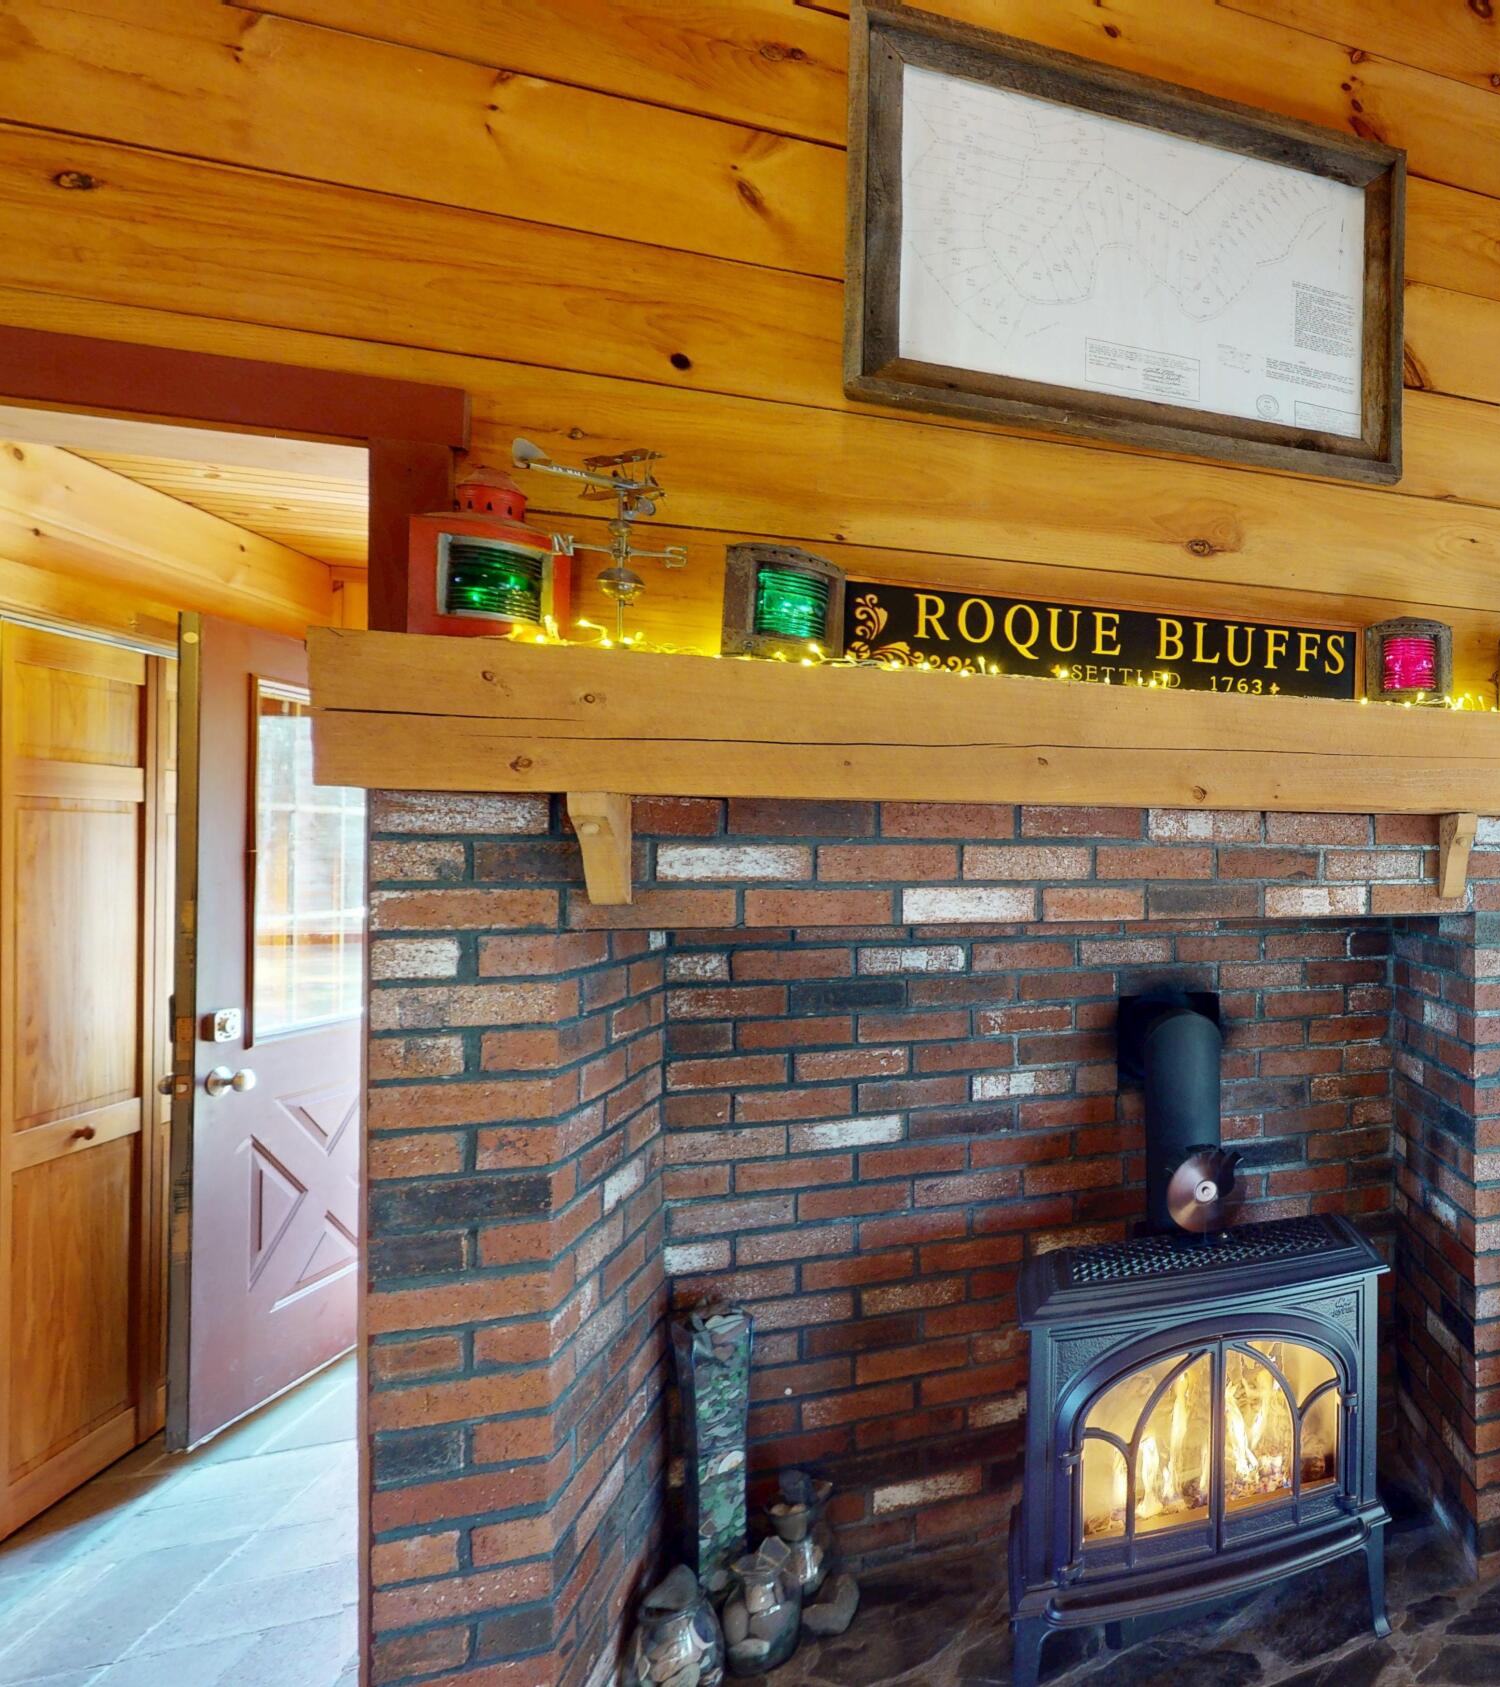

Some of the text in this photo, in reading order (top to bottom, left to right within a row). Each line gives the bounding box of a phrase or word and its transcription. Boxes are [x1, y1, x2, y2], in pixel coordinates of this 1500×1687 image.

[913, 593, 1345, 675] ROQUE BLUFFS
[1071, 664, 1263, 695] SETTLED 1763
